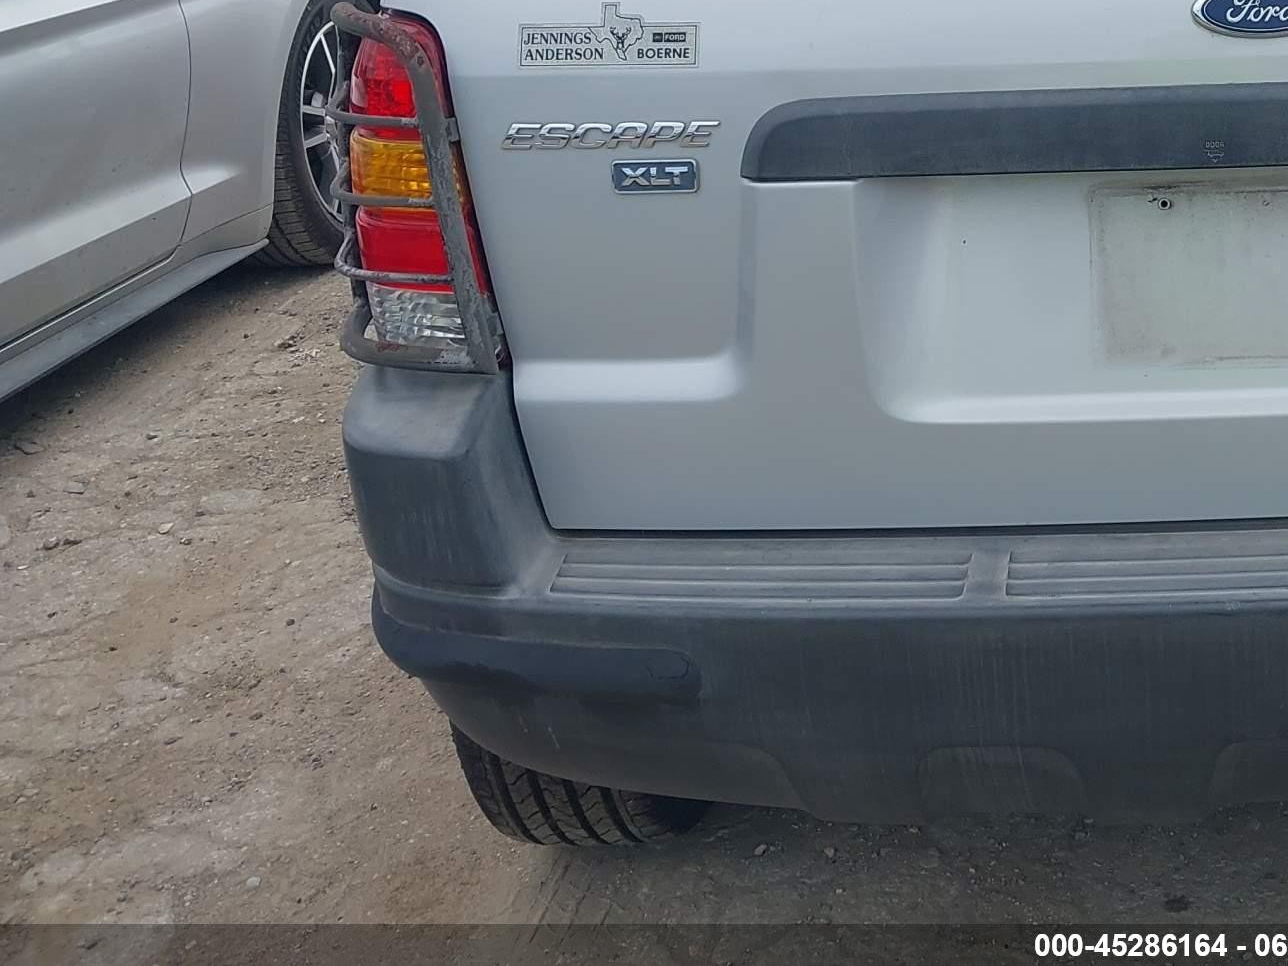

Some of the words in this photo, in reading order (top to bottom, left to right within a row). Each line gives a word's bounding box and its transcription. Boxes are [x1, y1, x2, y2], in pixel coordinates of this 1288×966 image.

[523, 32, 592, 45] JENNINGS
[524, 48, 604, 61] ANDERSON
[637, 48, 690, 59] BOERNE
[501, 120, 721, 151] ESCAPE
[620, 166, 690, 186] XLT
